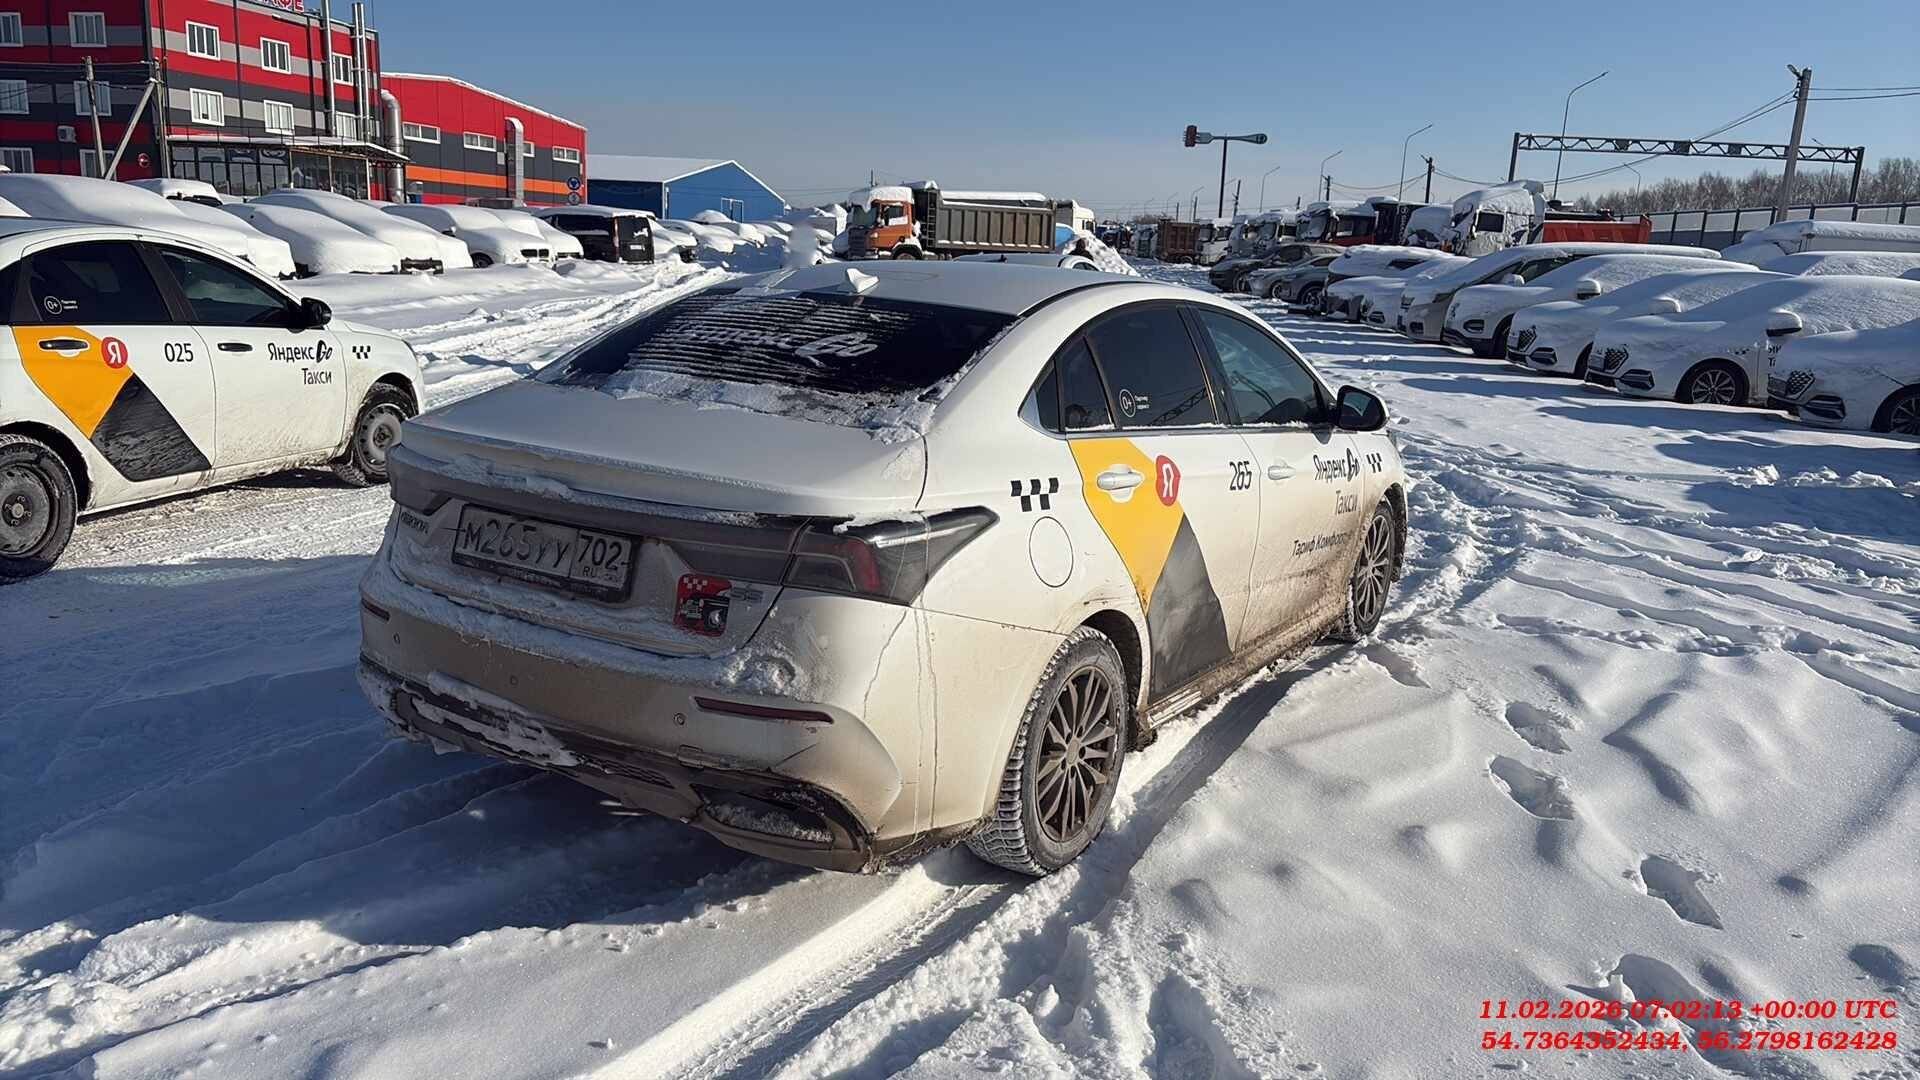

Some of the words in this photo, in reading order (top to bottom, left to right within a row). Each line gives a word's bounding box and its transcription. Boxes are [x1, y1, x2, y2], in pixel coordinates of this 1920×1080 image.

[107, 341, 123, 365] Я
[164, 342, 194, 363] 025
[267, 342, 315, 363] Яндекс
[316, 339, 333, 363] Go
[301, 367, 333, 385] Такси
[1229, 460, 1253, 491] 265
[1312, 454, 1347, 483] Яндекс
[1346, 447, 1361, 482] Go
[1334, 489, 1359, 516] Такси
[580, 534, 624, 571] 702
[1291, 536, 1316, 558] Тариф
